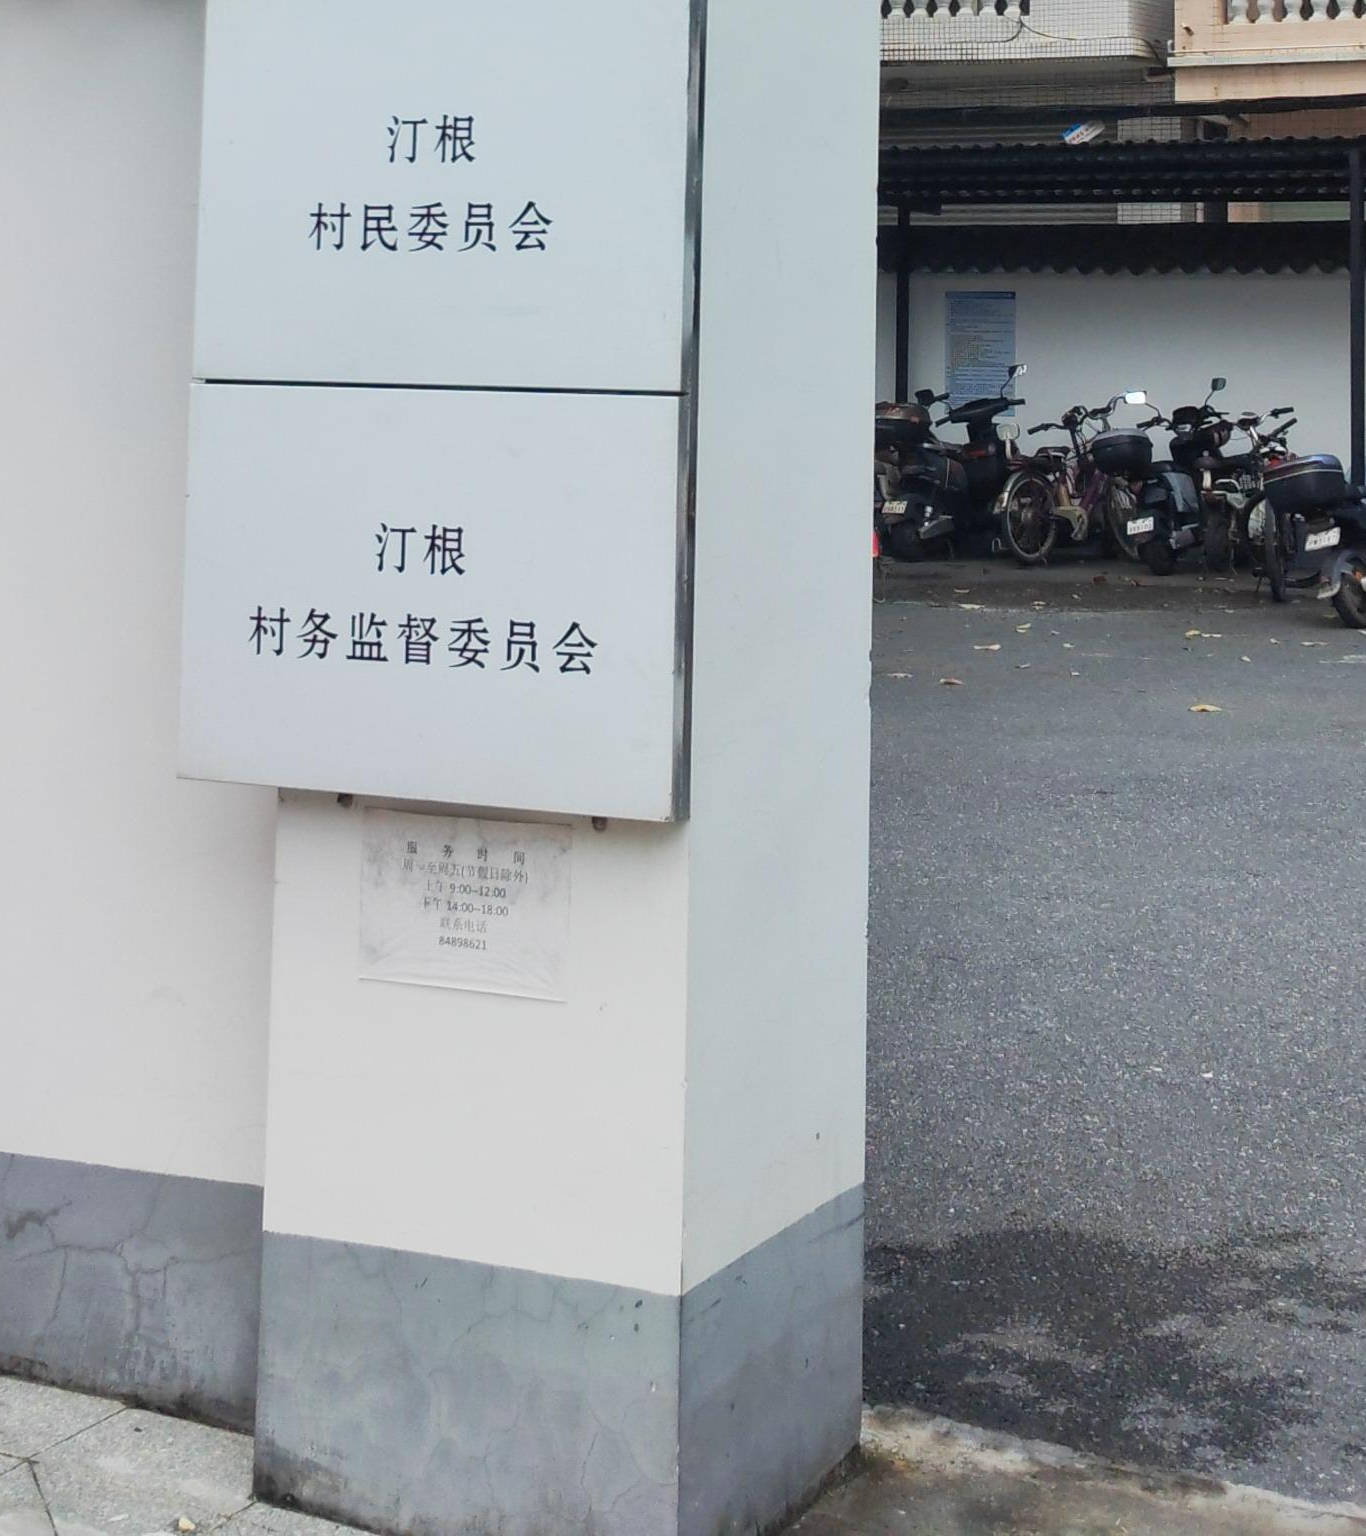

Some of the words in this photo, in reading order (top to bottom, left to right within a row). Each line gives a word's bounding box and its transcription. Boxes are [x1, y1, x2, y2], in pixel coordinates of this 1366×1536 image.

[386, 113, 477, 164] 汀根
[308, 200, 553, 253] 村民委员会
[373, 521, 467, 576] 汀根
[247, 605, 599, 676] 村务监督委员会
